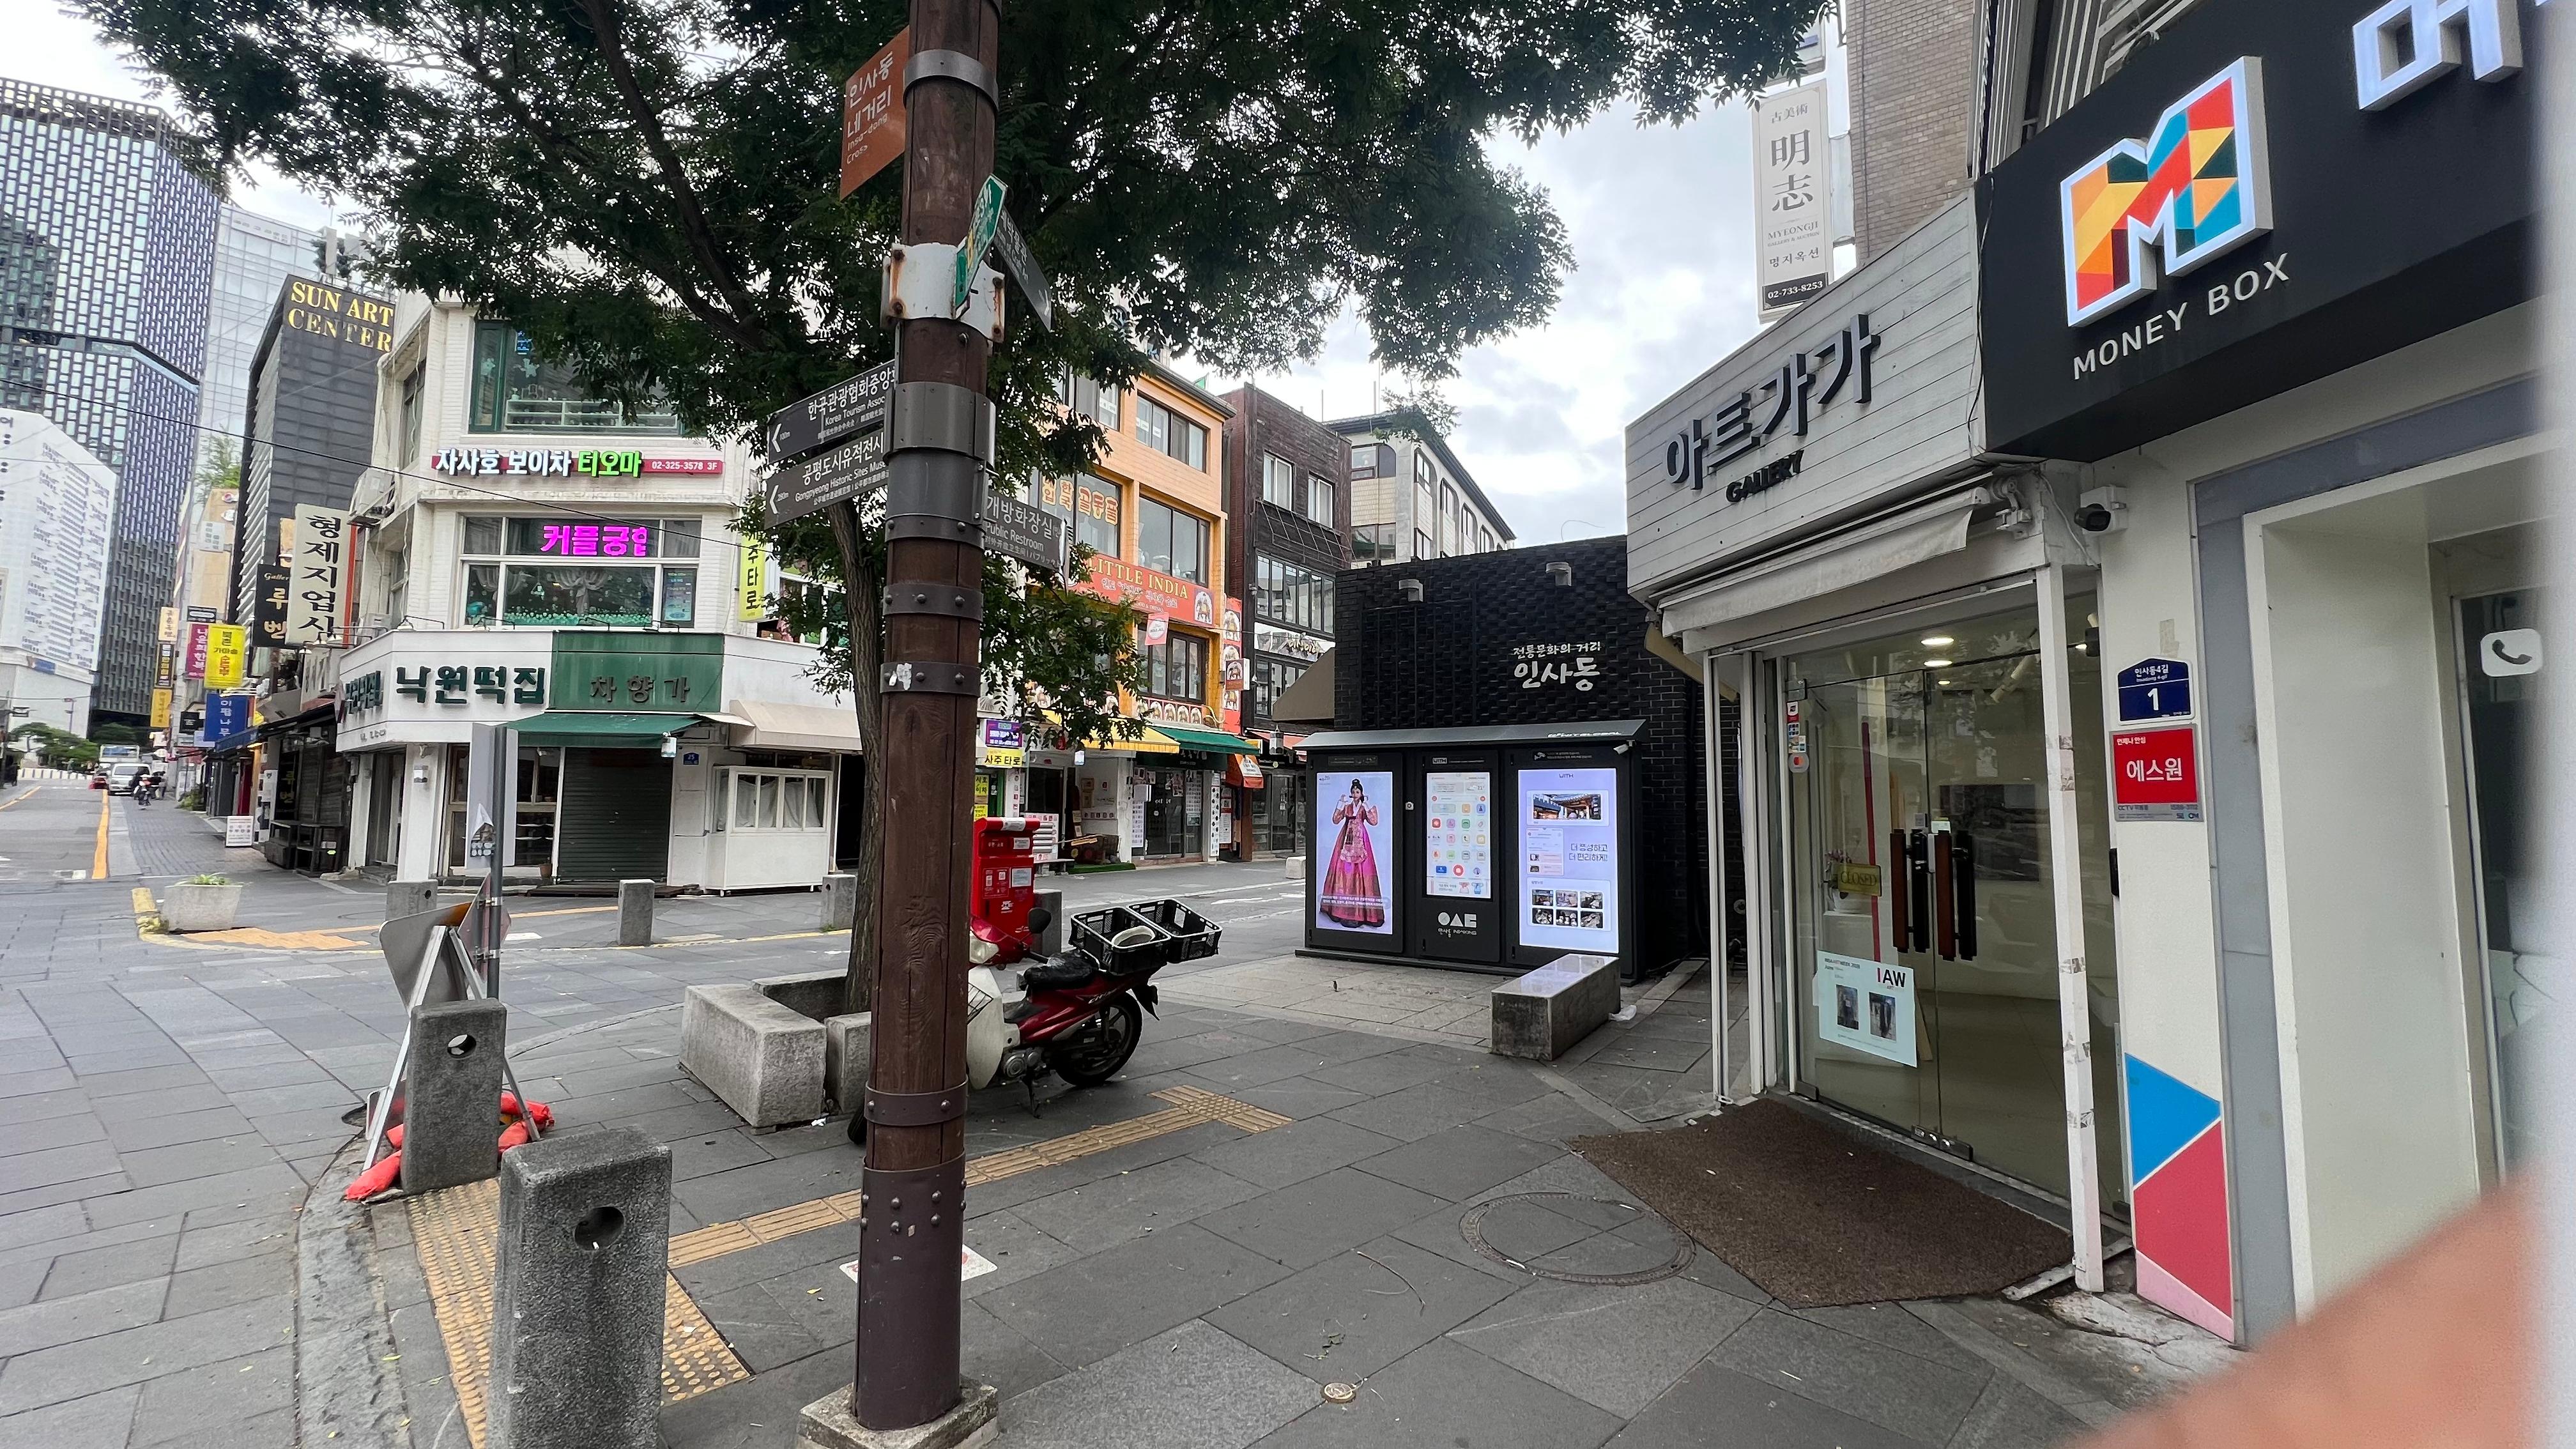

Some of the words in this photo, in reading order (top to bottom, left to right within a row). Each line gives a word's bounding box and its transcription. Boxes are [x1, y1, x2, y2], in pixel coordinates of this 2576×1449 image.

[850, 51, 893, 108] 인사동
[847, 85, 892, 137] 네거리
[1771, 103, 1809, 123] 古美術
[848, 113, 888, 151] Insa-dong
[847, 145, 868, 164] Cross
[1770, 129, 1814, 211] 明志
[1768, 221, 1819, 240] MYEONGJI
[1769, 247, 1820, 267] 명지옥션
[291, 281, 342, 312] SUN
[346, 298, 394, 327] ART
[1768, 280, 1823, 300] 02-733-8253
[288, 308, 392, 353] CENTER
[2073, 302, 2188, 381] MONEY
[2207, 252, 2291, 316] BOX
[808, 366, 894, 421] 한국관광협회중앙
[1662, 312, 1882, 491] 아트가가
[825, 414, 842, 426] Korea
[843, 404, 866, 418] Tourism
[867, 396, 885, 409] Assoc
[436, 448, 502, 476] 자사호
[506, 449, 572, 477] 보이차
[577, 450, 643, 478] 티오마
[652, 461, 703, 471] 02-325-3578
[707, 461, 717, 471] 3F
[802, 432, 884, 486] 공평도시유적전시
[1726, 449, 1804, 503] GALLERY
[795, 483, 829, 502] Gongpyeong
[830, 473, 853, 489] Historic
[854, 466, 868, 479] Sites
[870, 461, 887, 473] Muse
[987, 496, 1052, 540] 개방화장실
[985, 521, 1009, 540] Public
[1010, 529, 1044, 551] Restroom
[746, 540, 760, 610] 주타로
[1089, 558, 1144, 585] LITTLE
[1149, 574, 1188, 599] INDIA
[1513, 643, 1571, 659] 전통문화의
[1576, 641, 1601, 652] 거리
[396, 666, 546, 705] 낙원떡집
[1514, 657, 1600, 691] 인사동
[2135, 664, 2169, 677] 인사동4길
[590, 675, 691, 703] 차향가
[2147, 687, 2159, 711] 1
[985, 755, 1002, 765] 사주
[1004, 756, 1021, 765] 타로
[2126, 757, 2183, 782] 에스원
[1841, 871, 1878, 886] CLOSED
[1877, 967, 1906, 988] IAW
